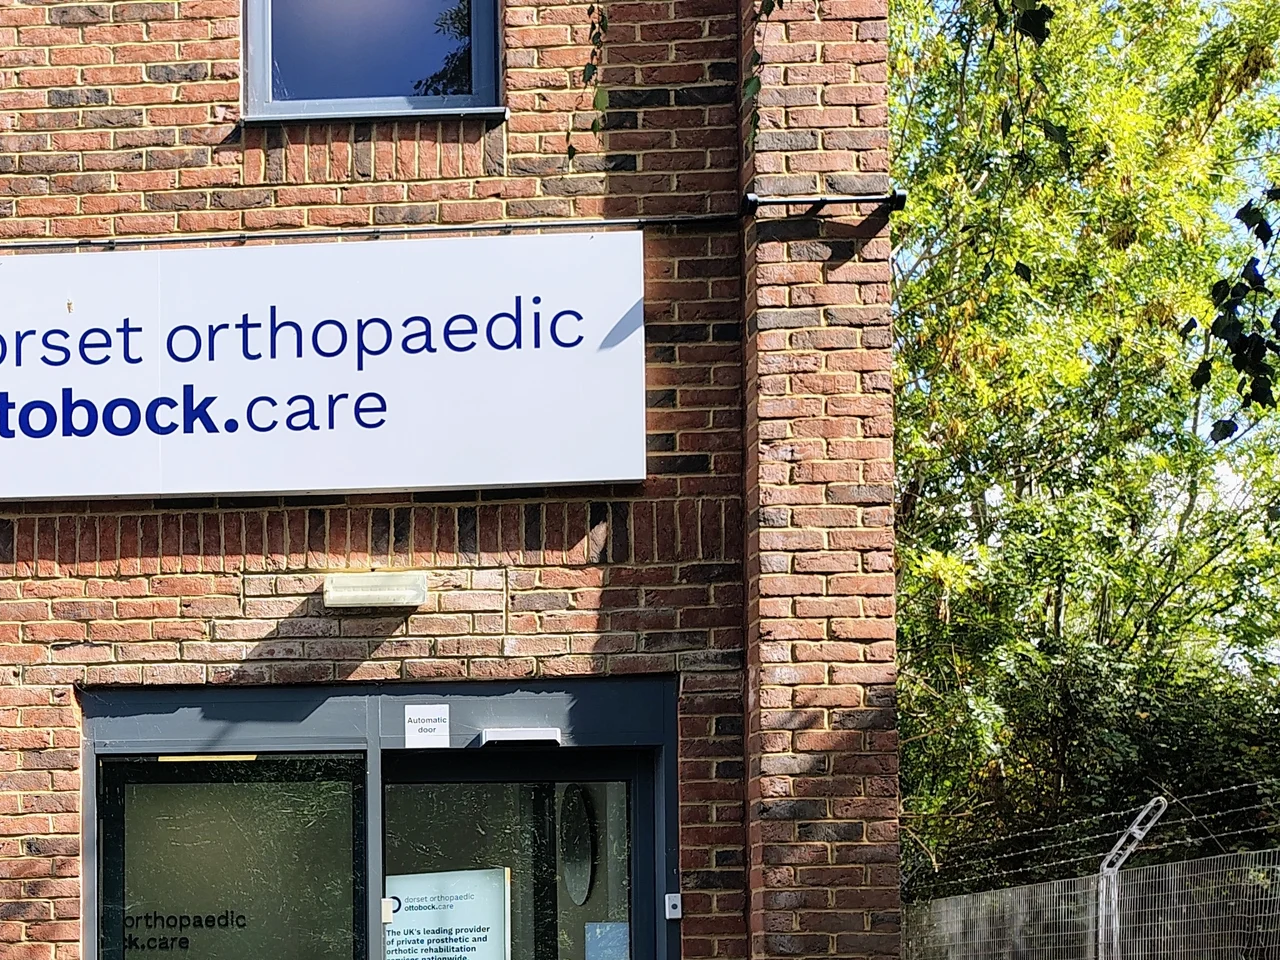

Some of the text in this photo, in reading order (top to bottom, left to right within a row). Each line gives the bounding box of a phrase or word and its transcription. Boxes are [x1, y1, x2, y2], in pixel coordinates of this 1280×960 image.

[166, 295, 585, 371] orthopaedic
[407, 716, 447, 724] Automatic
[417, 726, 437, 734] door
[404, 893, 475, 904] dorset orthopaedic
[404, 903, 454, 911] ottobock.care
[123, 910, 247, 932] orthopaedic
[386, 925, 491, 937] The UK's leading provider
[386, 938, 395, 946] of
[396, 938, 425, 947] private
[426, 936, 470, 945] prosthetic
[386, 945, 477, 955] orthotic rehabilitation
